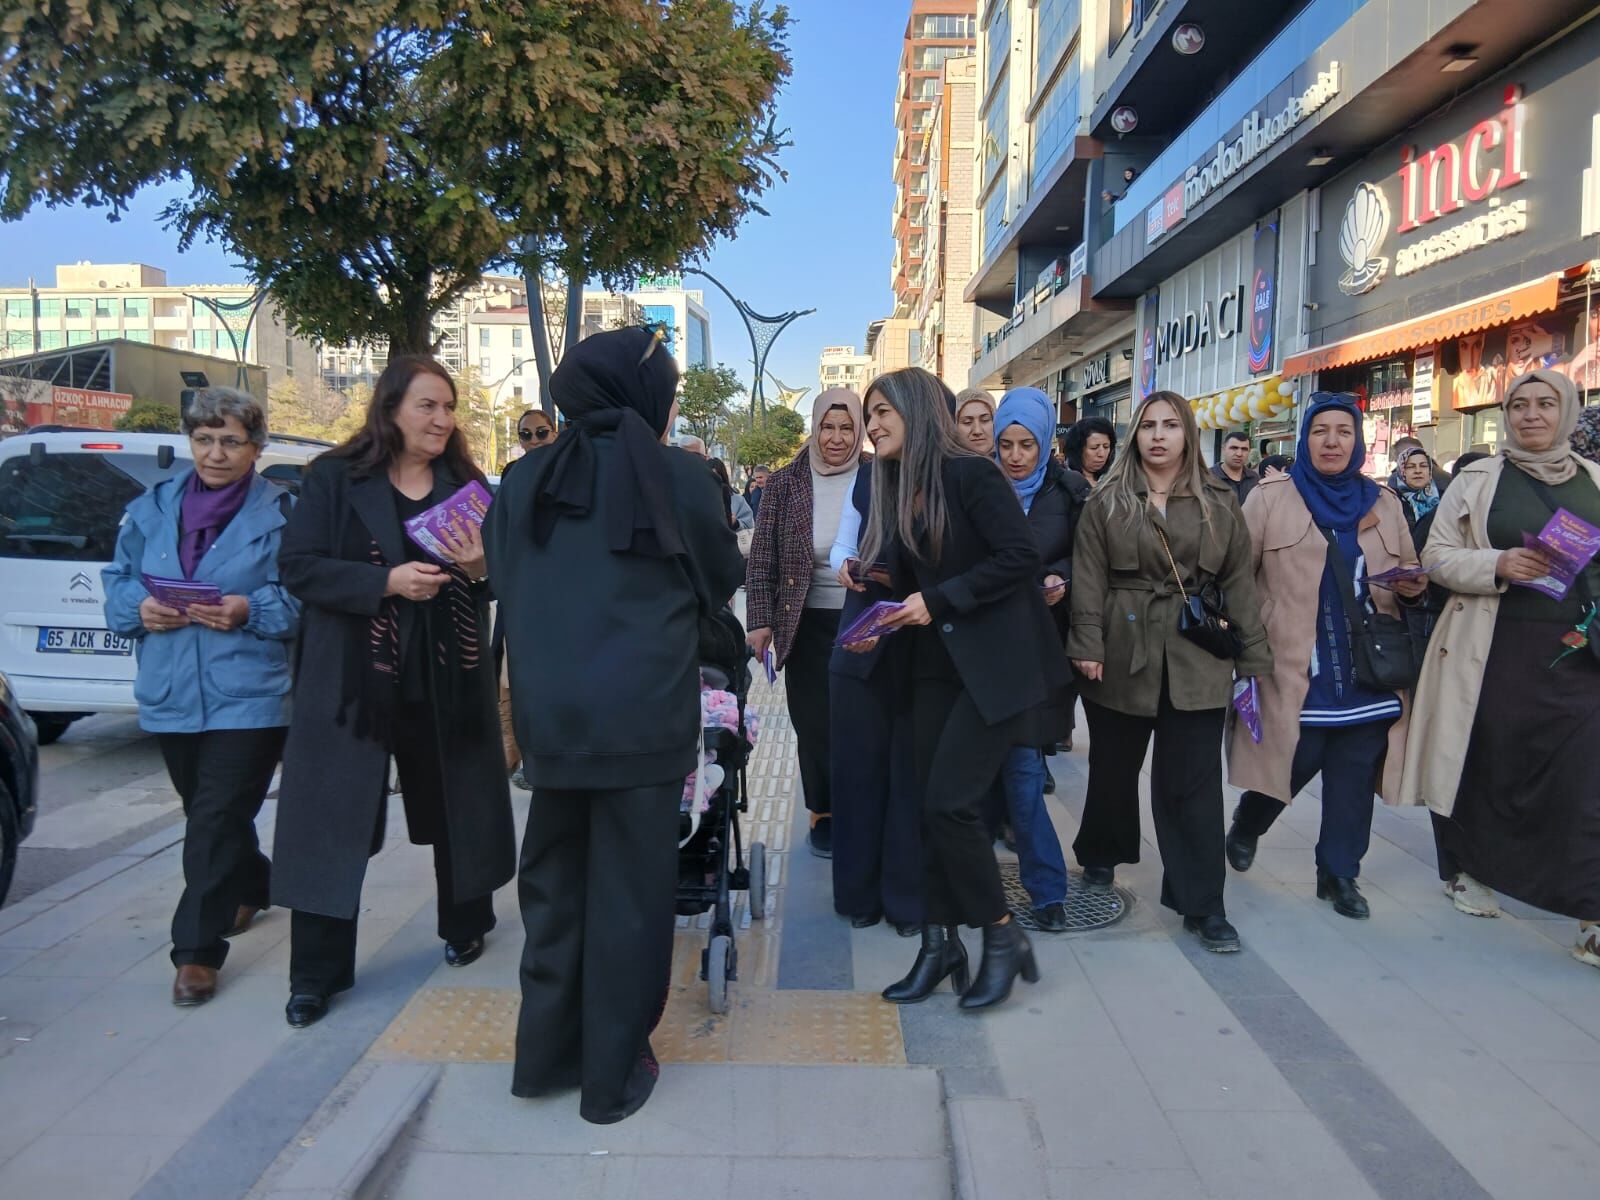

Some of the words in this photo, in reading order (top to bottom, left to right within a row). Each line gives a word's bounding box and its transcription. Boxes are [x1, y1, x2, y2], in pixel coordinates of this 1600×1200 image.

[1397, 83, 1528, 233] inci
[1155, 284, 1245, 366] MODACI
[47, 631, 64, 646] 65
[70, 631, 95, 648] ACK
[103, 633, 128, 649] 892
